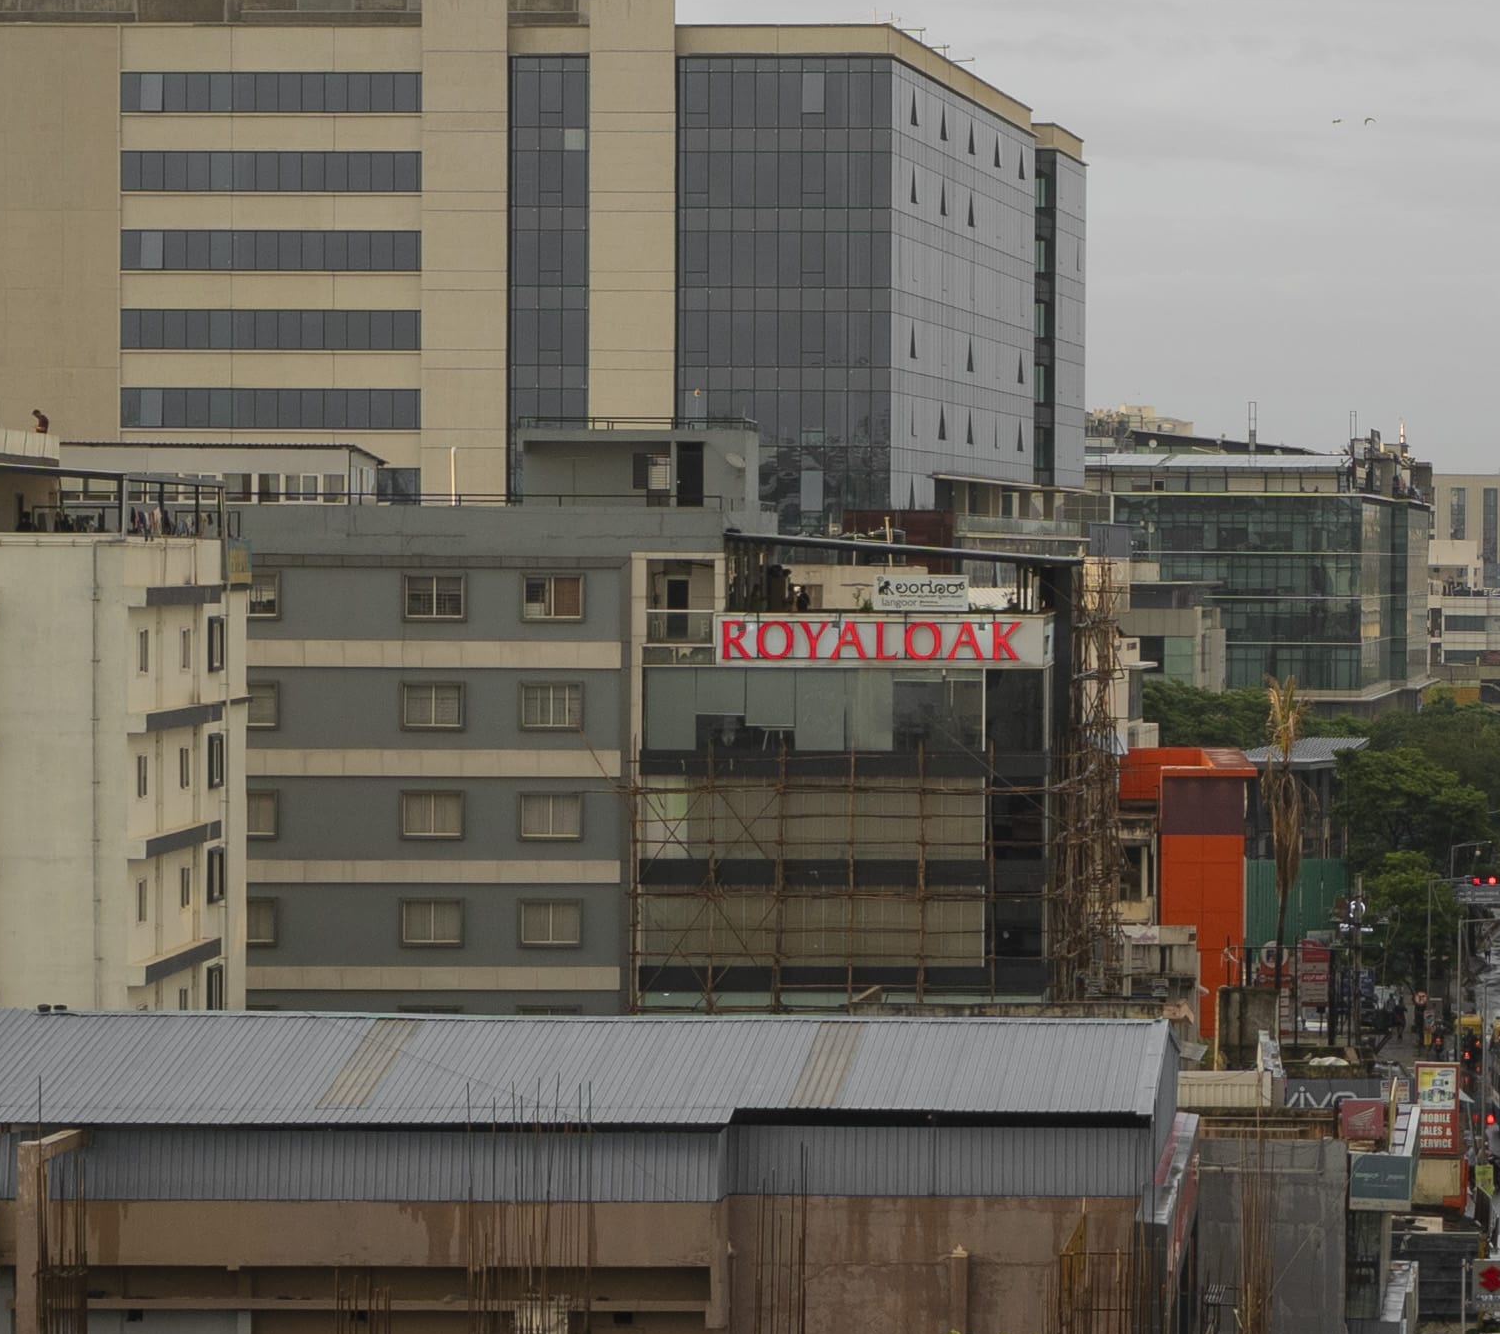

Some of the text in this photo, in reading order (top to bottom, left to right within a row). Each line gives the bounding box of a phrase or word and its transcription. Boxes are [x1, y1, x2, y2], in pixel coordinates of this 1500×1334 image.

[895, 579, 965, 595] ಲಂಗೂರ್
[881, 599, 917, 609] langoor
[721, 620, 1022, 661] ROYALOAK
[1420, 1113, 1451, 1123] MOBILE
[1420, 1125, 1452, 1136] SALES &
[1420, 1138, 1452, 1149] SERVICE
